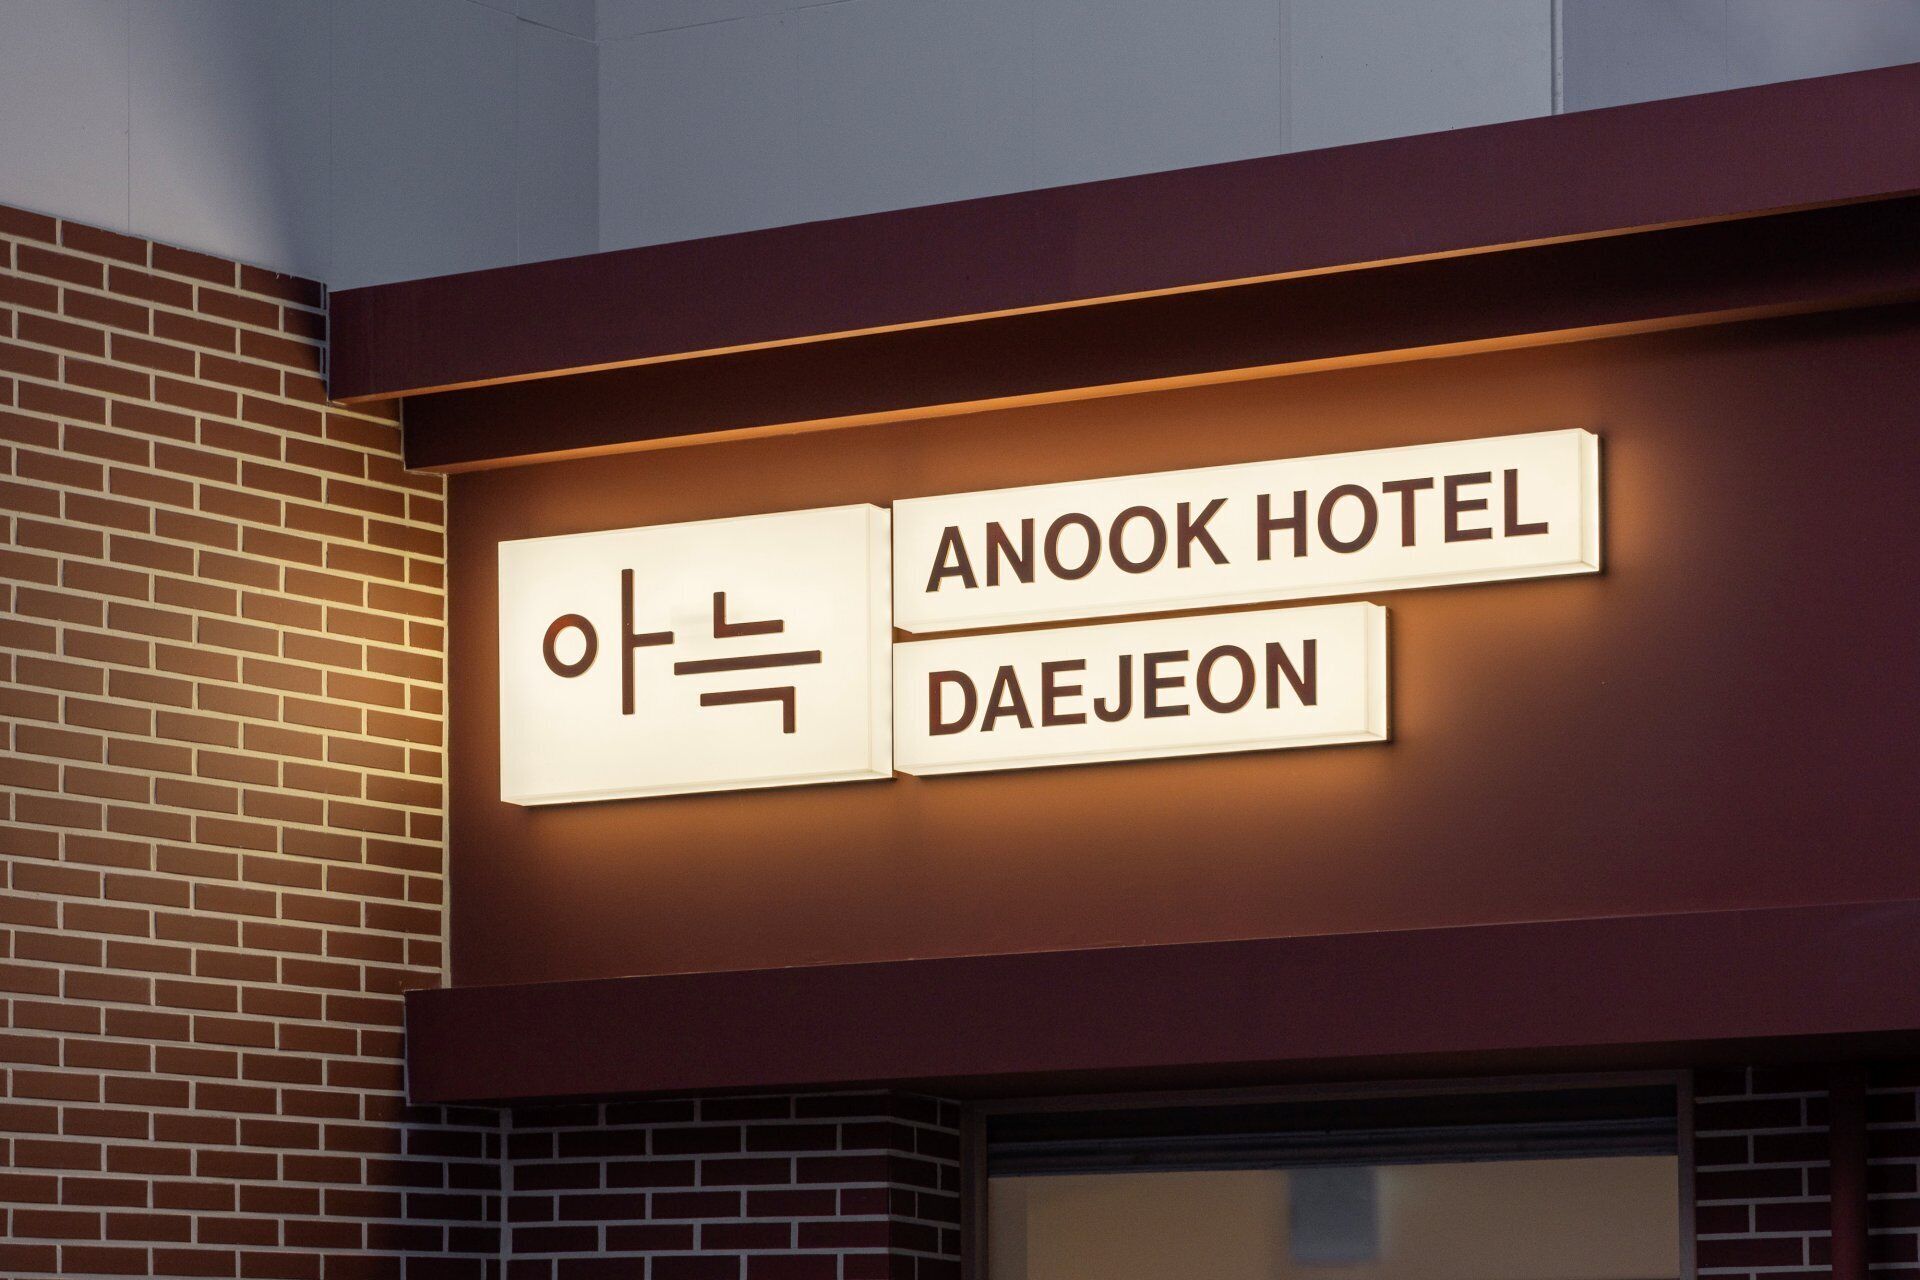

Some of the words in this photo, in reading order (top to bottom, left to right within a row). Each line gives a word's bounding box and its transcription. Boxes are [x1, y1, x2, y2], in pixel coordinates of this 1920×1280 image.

[925, 497, 1230, 593] ANOOK
[1256, 468, 1549, 562] HOTEL
[542, 568, 822, 734] 아늑
[928, 638, 1317, 737] DAEJEON
